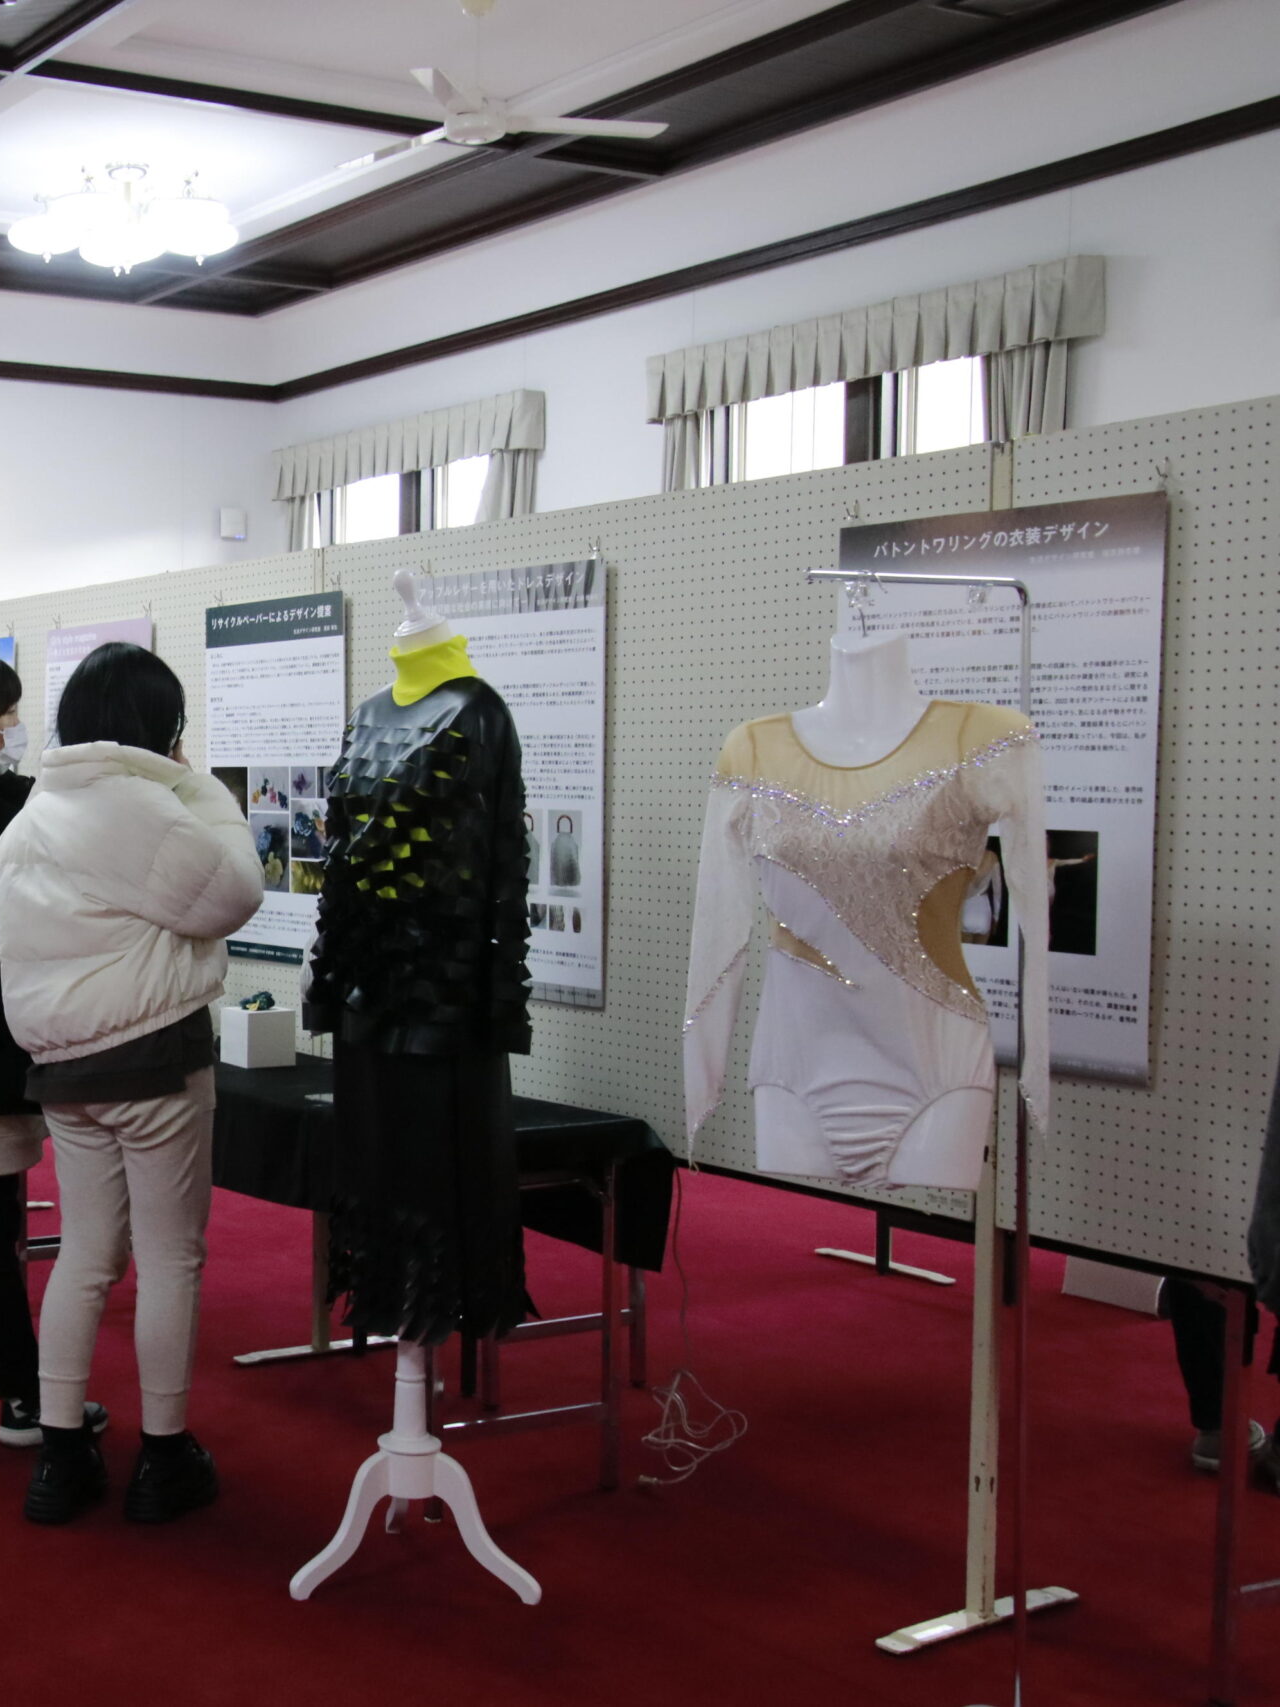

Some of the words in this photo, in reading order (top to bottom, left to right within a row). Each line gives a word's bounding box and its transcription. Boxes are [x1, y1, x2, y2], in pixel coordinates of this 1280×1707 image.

[873, 521, 1111, 559] バトントワリングの衣装デザイン
[211, 604, 332, 631] リサイクルペーパーによるデザイン提案
